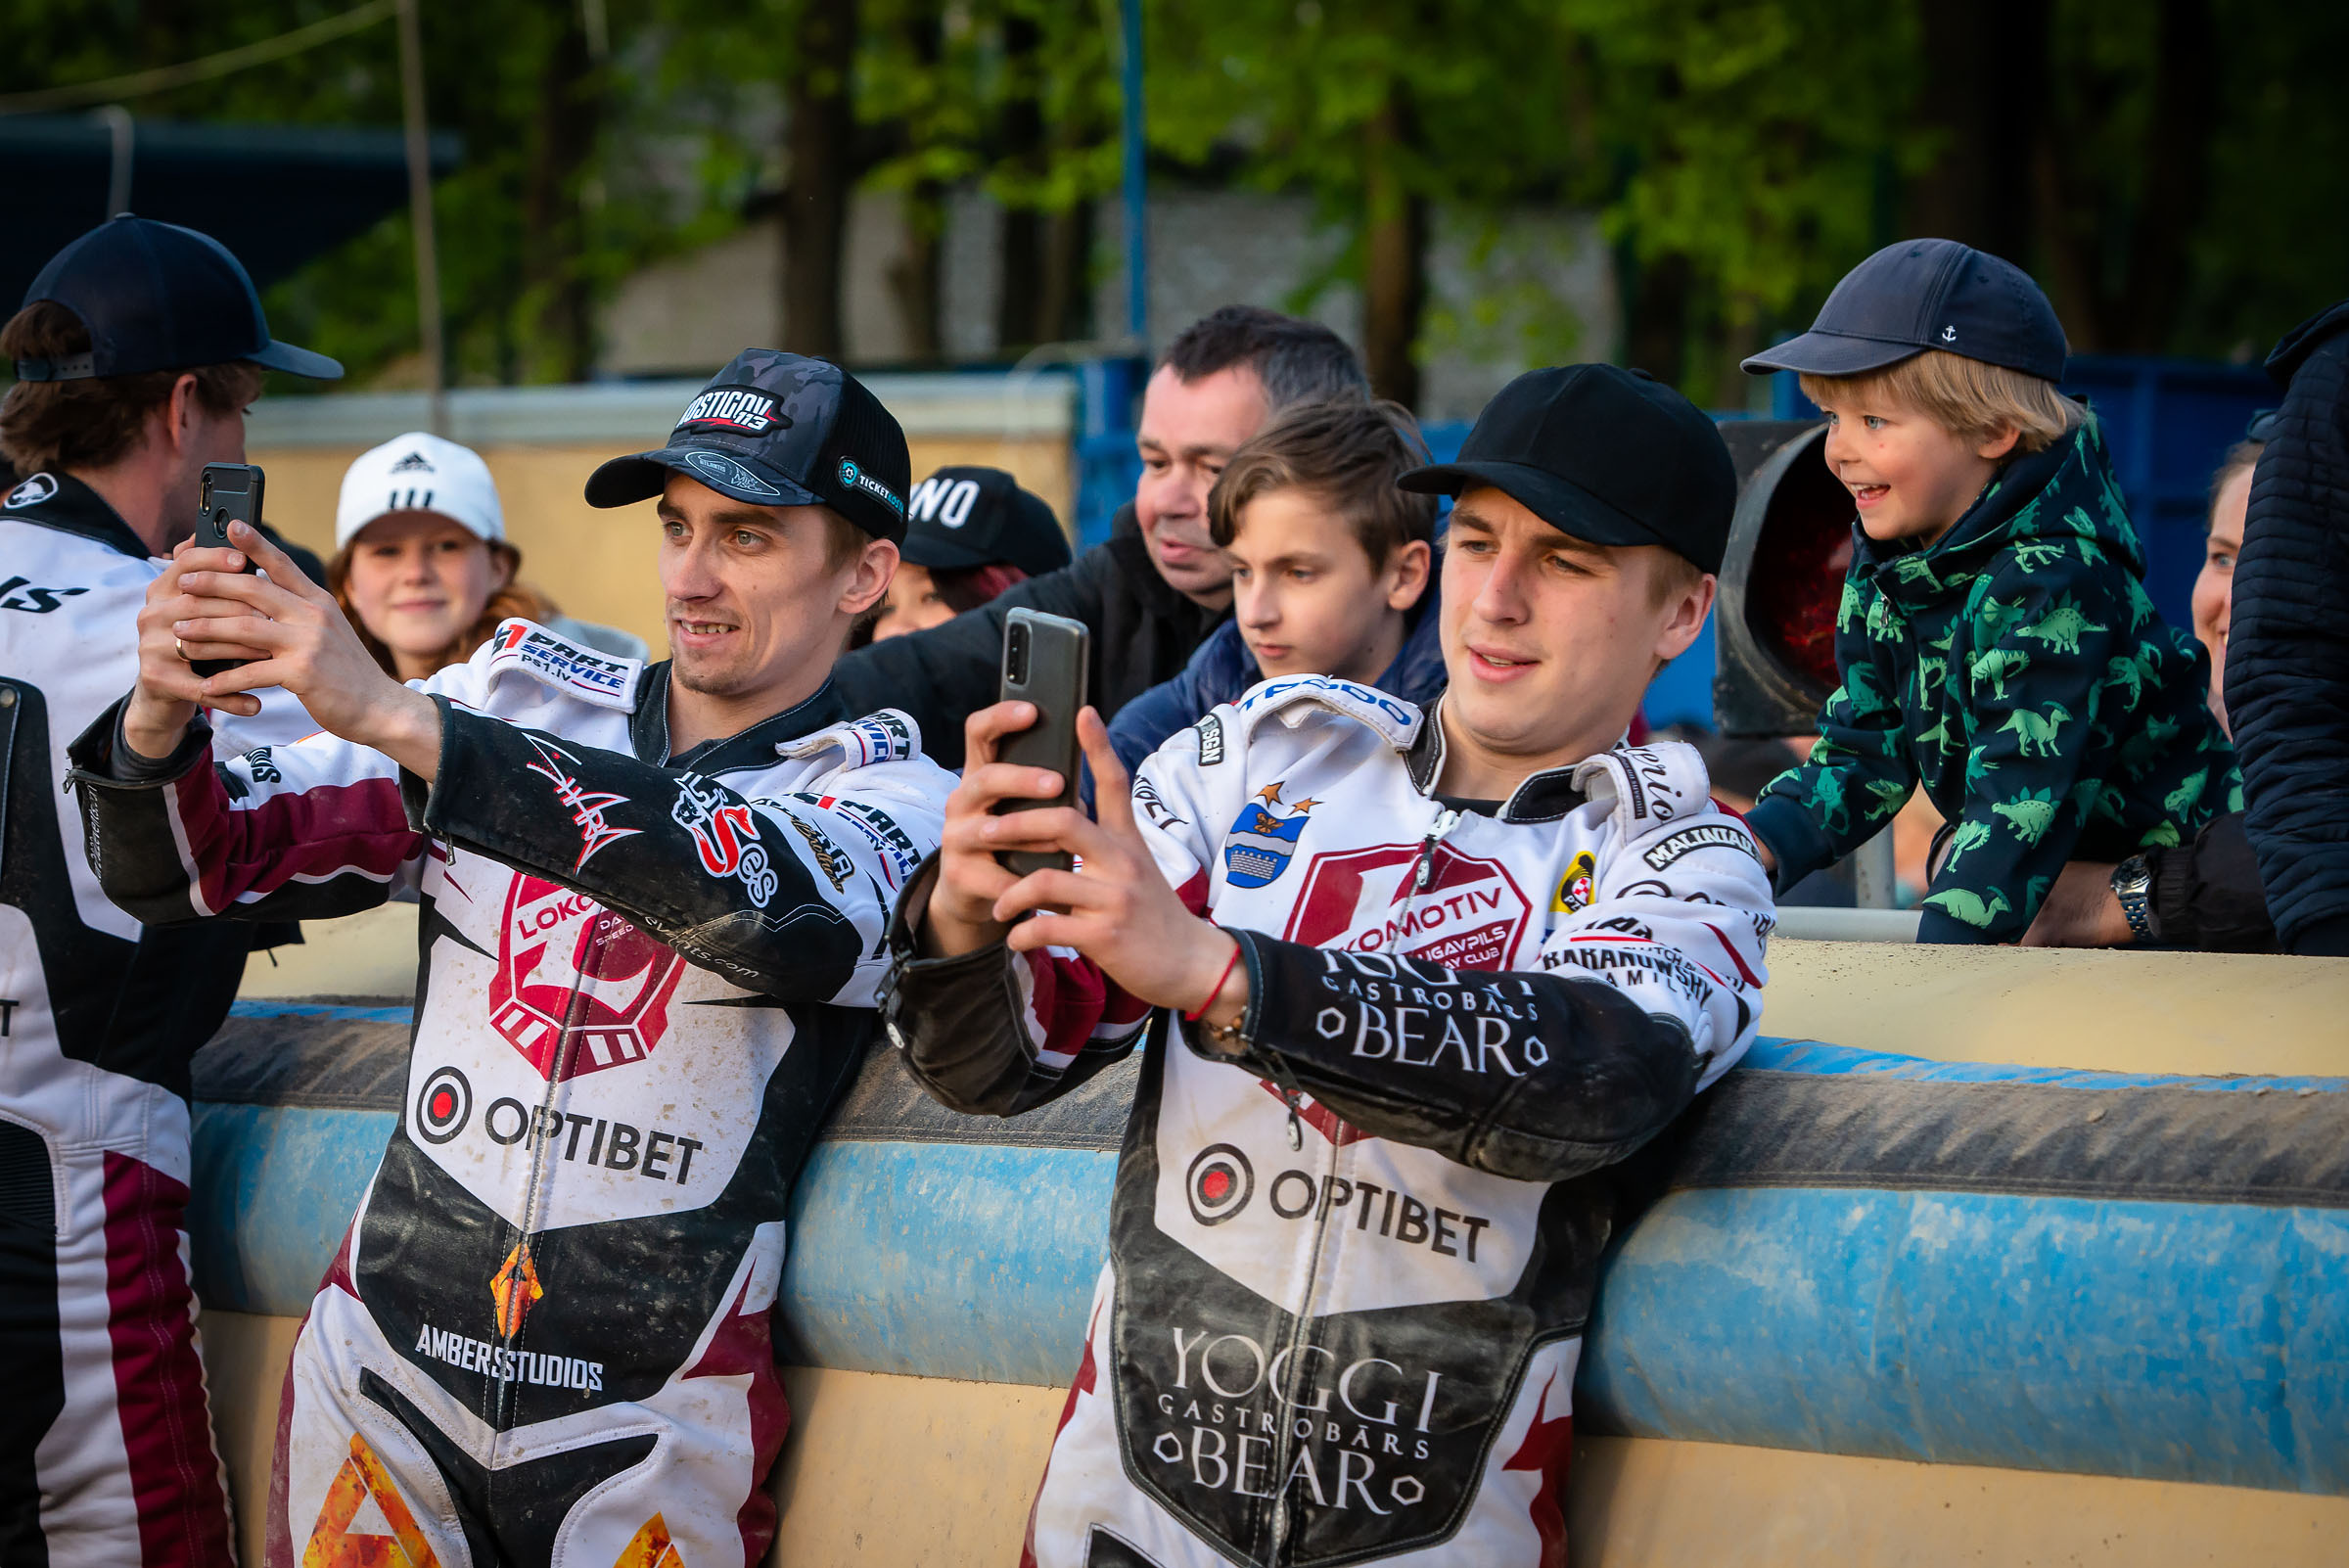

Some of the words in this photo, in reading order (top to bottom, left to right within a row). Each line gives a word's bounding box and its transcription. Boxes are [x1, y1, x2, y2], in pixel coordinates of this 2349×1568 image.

[734, 411, 769, 431] 113
[909, 478, 981, 529] NO
[521, 644, 625, 689] SERVICE
[521, 654, 572, 681] ps1.lv
[528, 632, 629, 672] PART
[518, 896, 595, 940] LOKO
[600, 915, 624, 931] DA
[1418, 926, 1507, 963] UGAVPILS
[1463, 946, 1500, 965] CLUB
[1605, 969, 1693, 1001] AMILY
[1352, 1000, 1527, 1078] BEAR
[485, 1097, 703, 1185] OPTIBET
[1270, 1170, 1491, 1263] OPTIBET
[1173, 1327, 1443, 1433] YOGGI
[1158, 1394, 1430, 1460] GASTROBĀRS
[1191, 1426, 1393, 1515] BEAR
